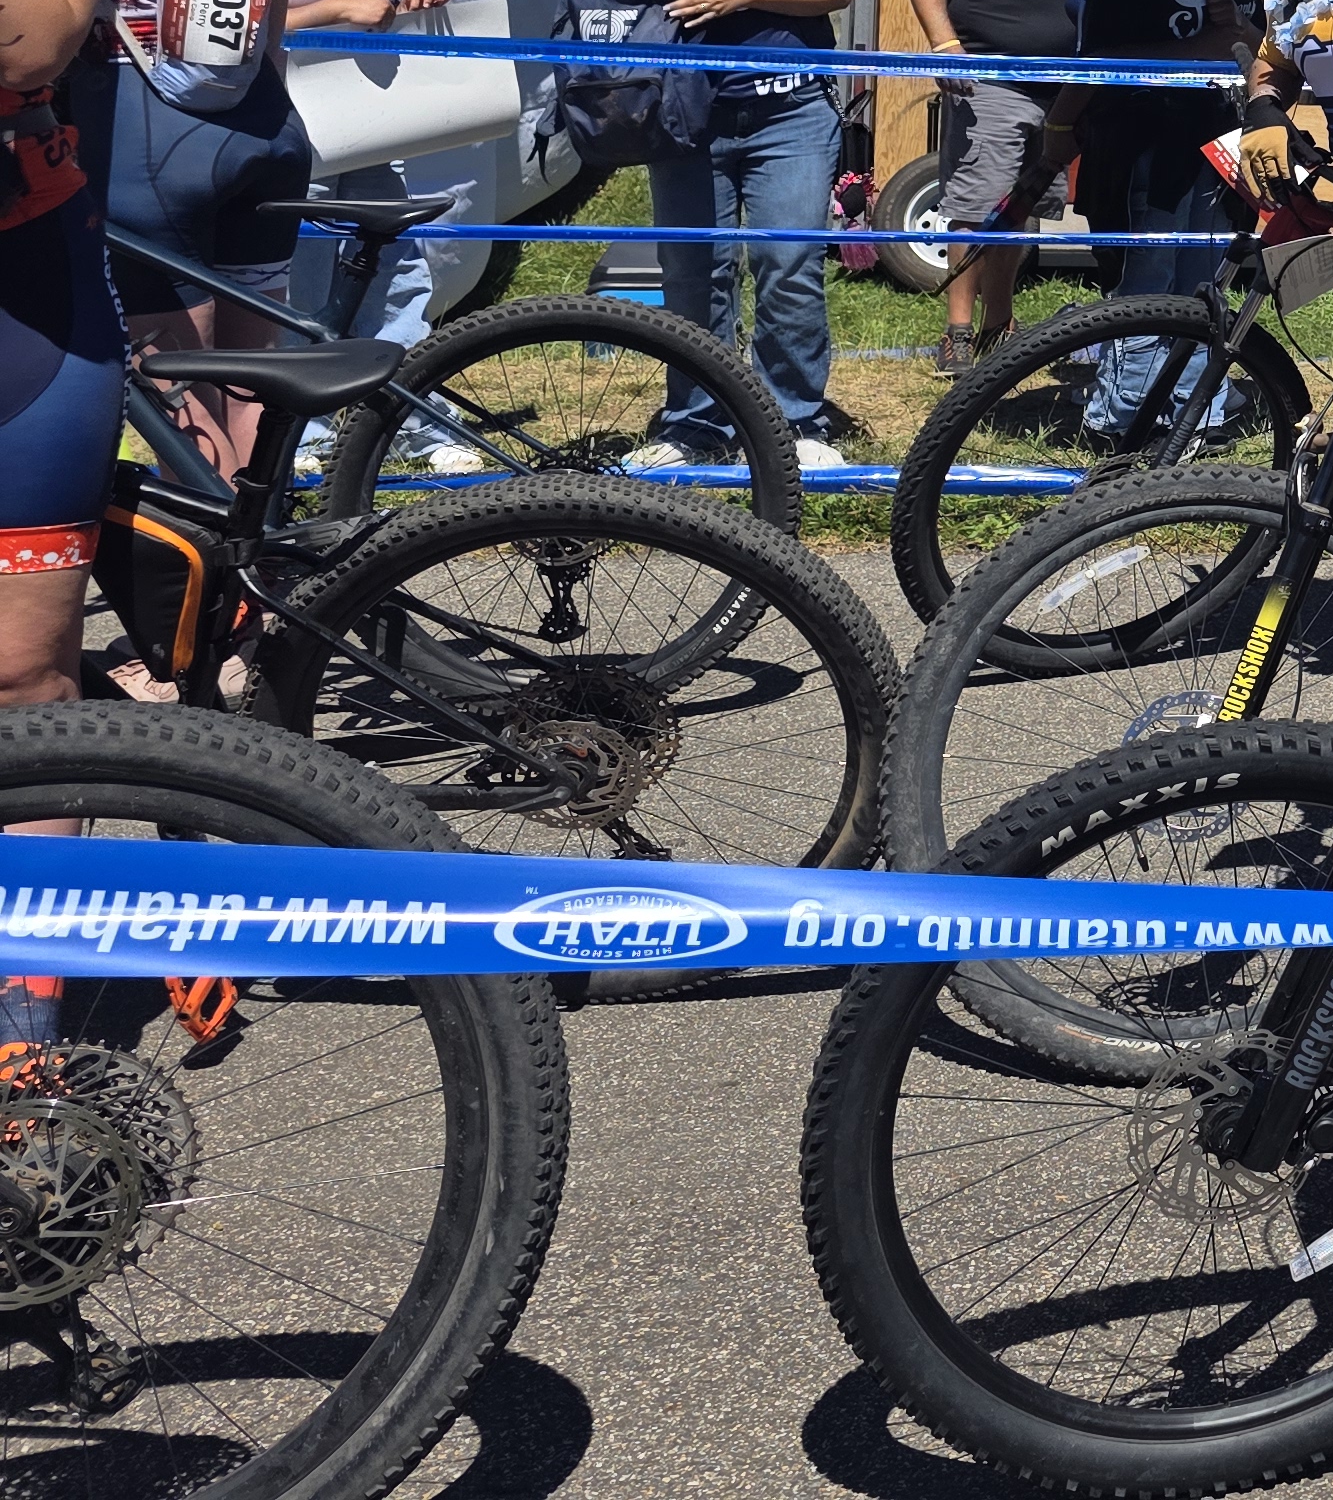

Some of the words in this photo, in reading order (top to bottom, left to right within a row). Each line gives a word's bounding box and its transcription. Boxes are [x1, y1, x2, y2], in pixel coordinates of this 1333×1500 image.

[195, 2, 210, 29] Perry
[1095, 492, 1262, 521] CONTINENTAL
[1219, 622, 1275, 723] ROCKSHOX
[1040, 770, 1243, 859] MAXXIS
[563, 894, 627, 912] LEAGUE
[539, 914, 703, 947] UTAH
[560, 945, 623, 959] SCHOOL
[632, 946, 672, 956] HIGH
